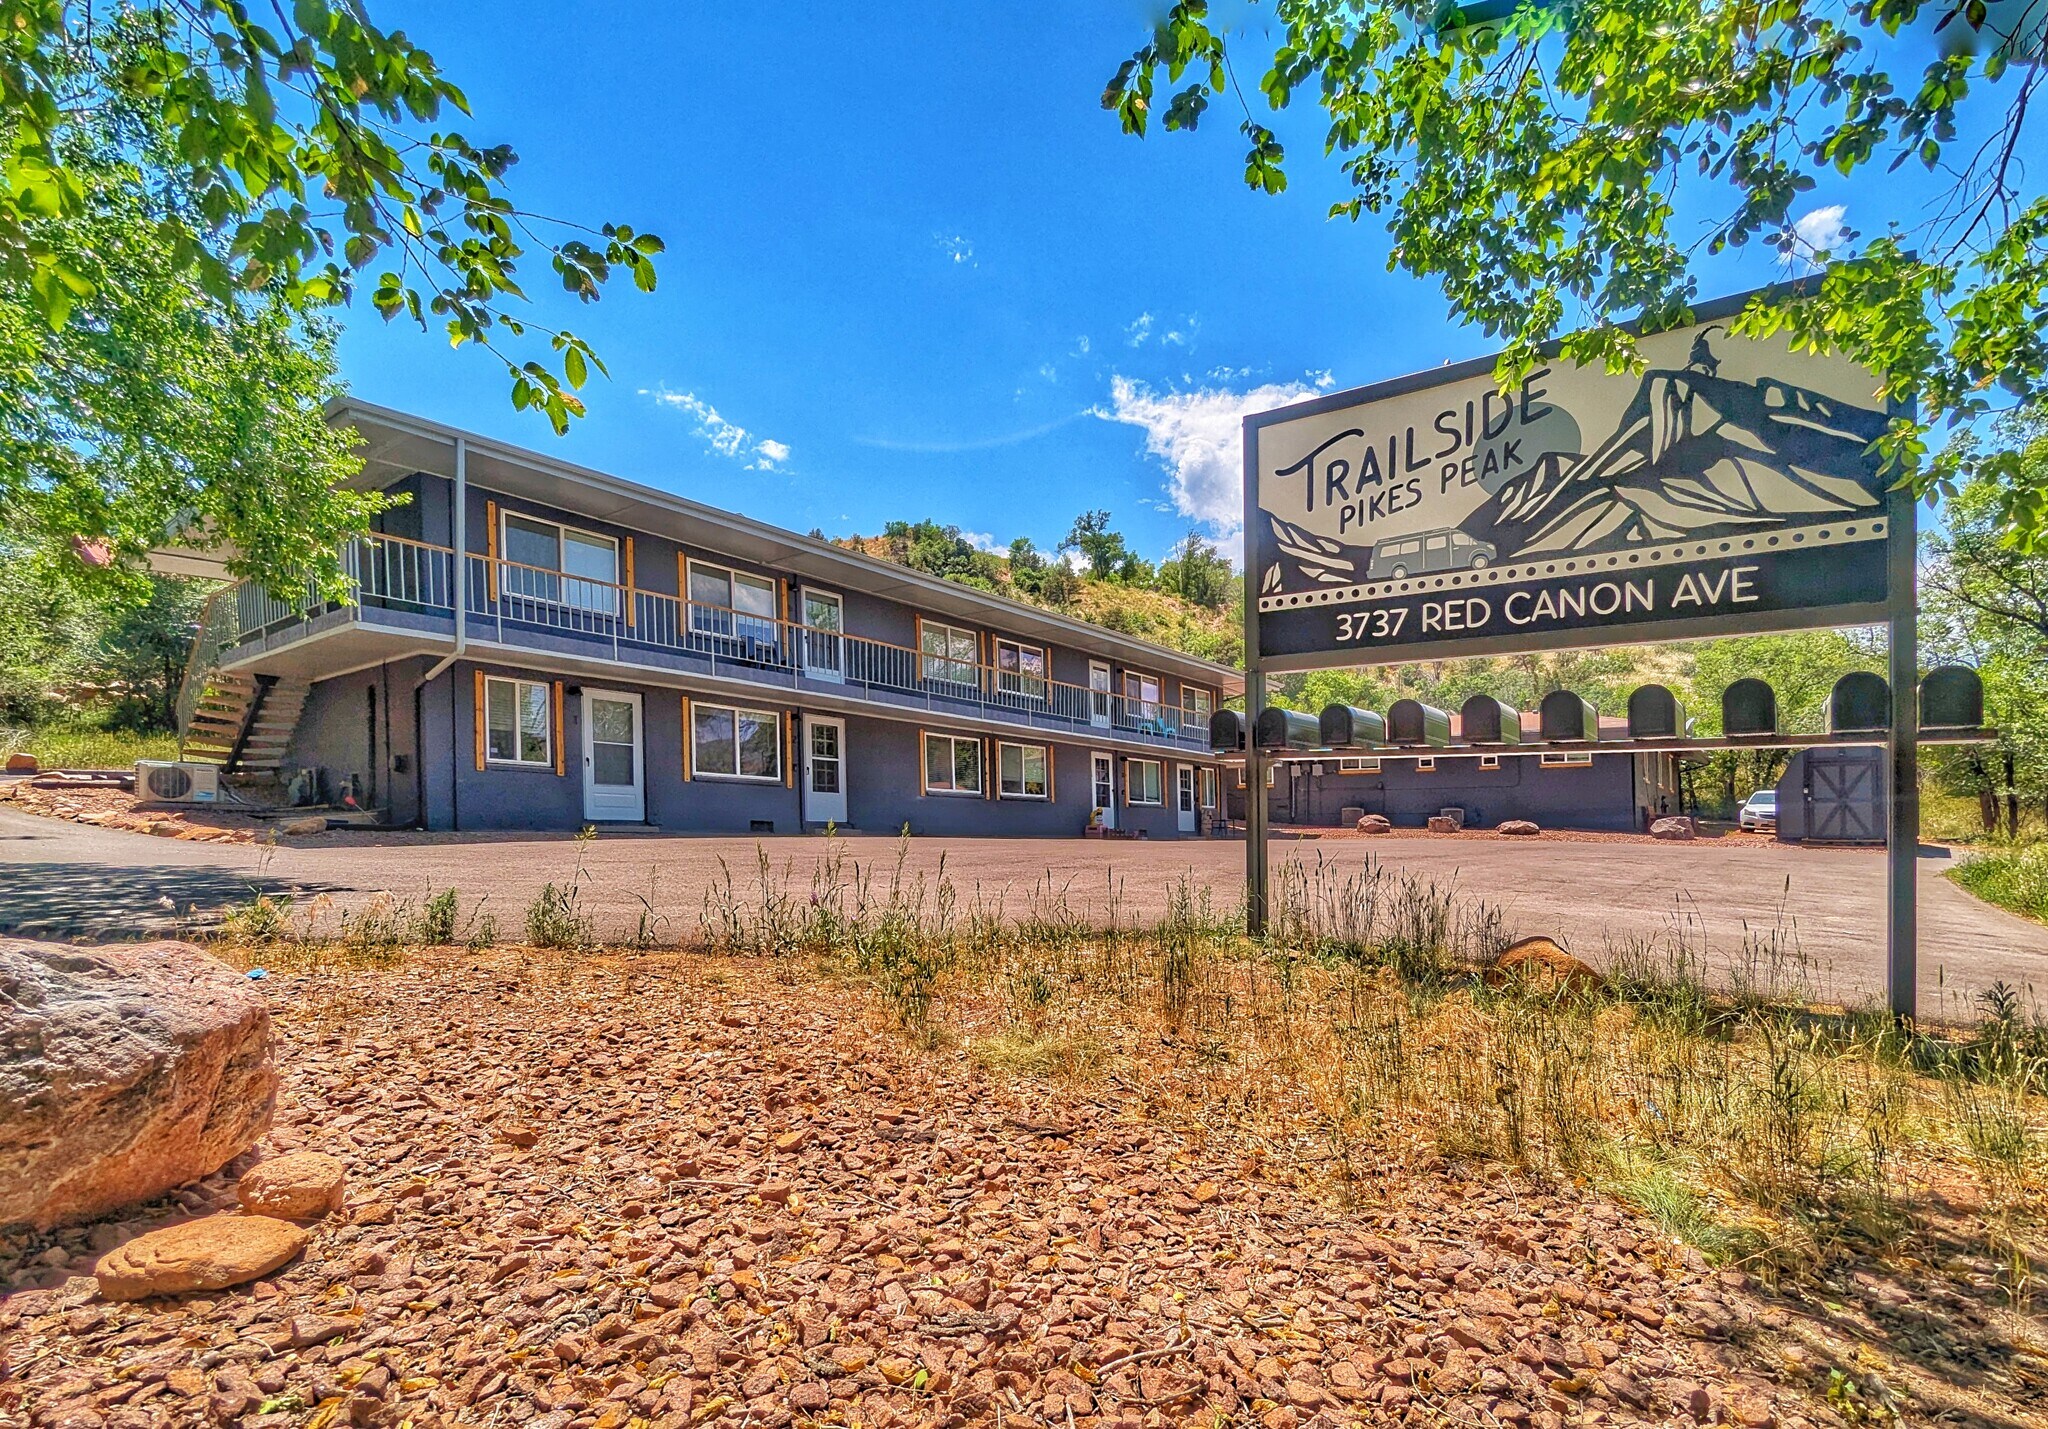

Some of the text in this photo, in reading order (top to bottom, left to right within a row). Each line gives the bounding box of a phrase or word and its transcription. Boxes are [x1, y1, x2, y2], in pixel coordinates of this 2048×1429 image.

[1275, 368, 1553, 512] TRAILSIDE
[1340, 438, 1523, 534] PIKES PEAK
[1335, 566, 1759, 641] 3737 RED CANON AVE
